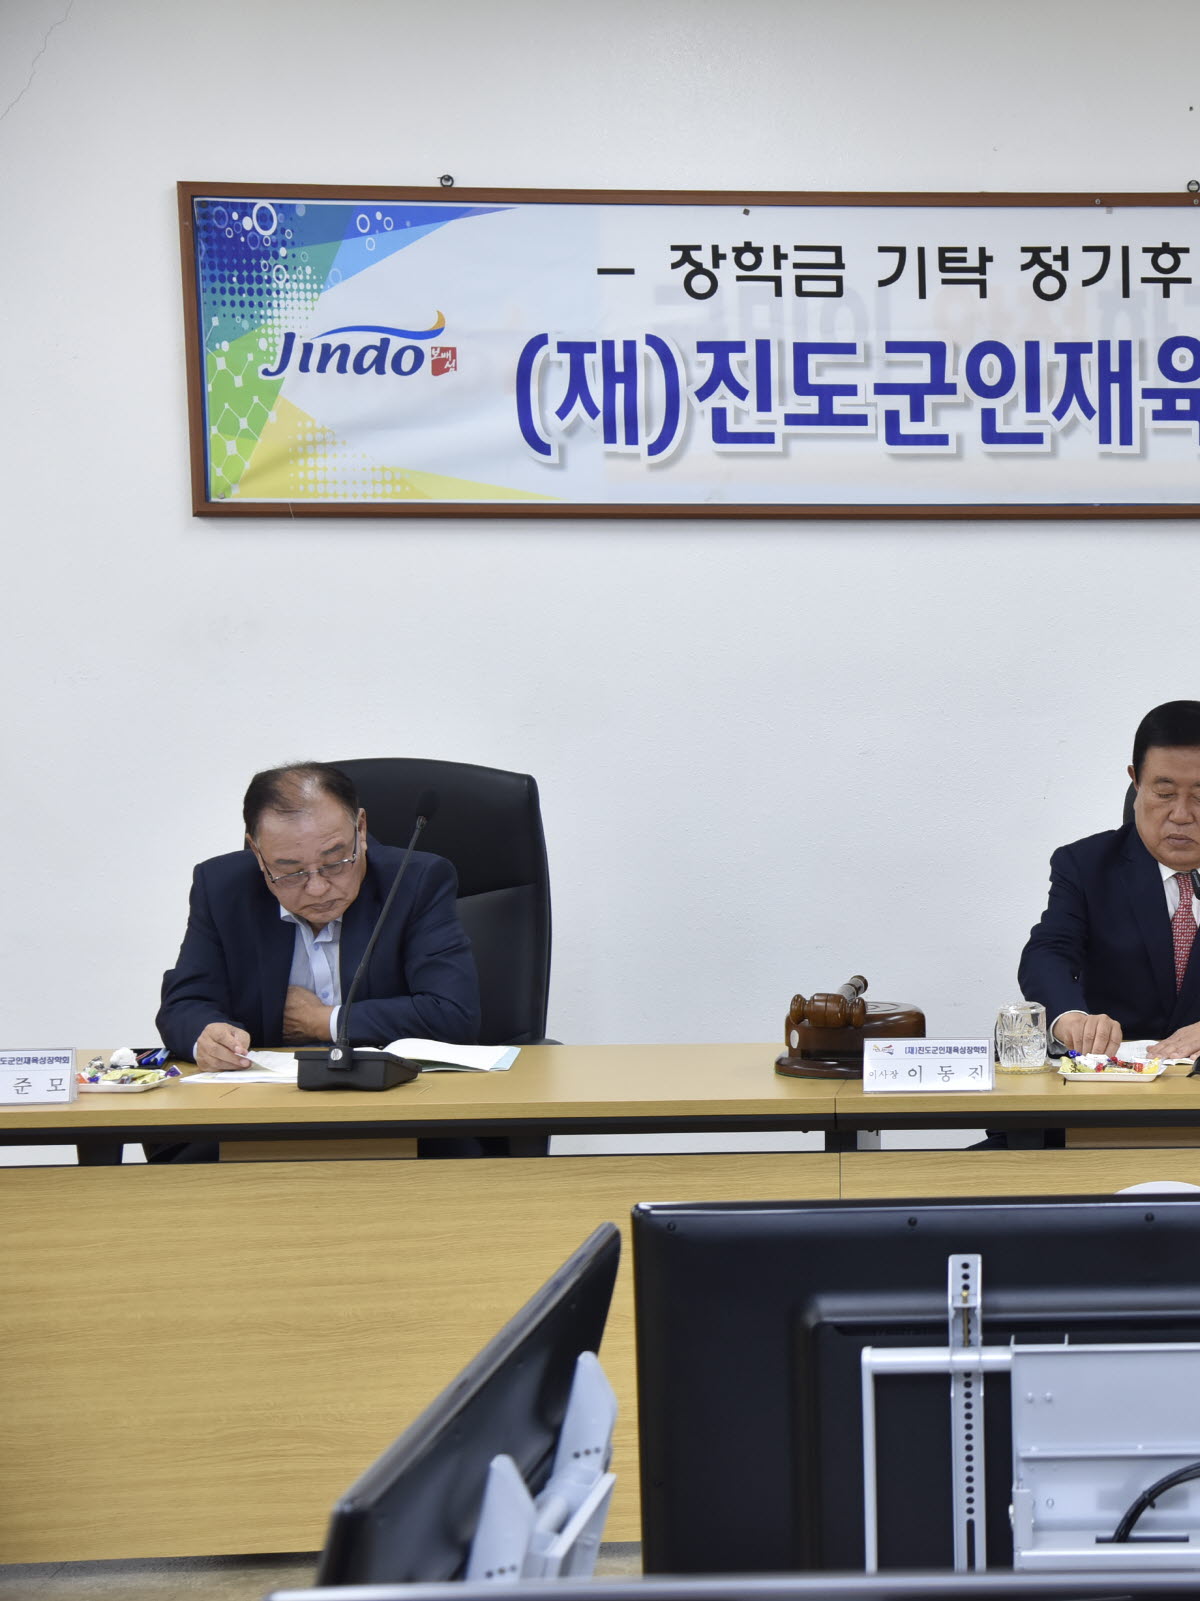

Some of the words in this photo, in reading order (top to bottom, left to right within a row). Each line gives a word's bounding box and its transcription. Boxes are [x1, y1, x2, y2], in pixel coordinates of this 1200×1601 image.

[670, 241, 846, 301] 장학금
[877, 244, 994, 300] 기탁
[261, 332, 425, 377] Jindo
